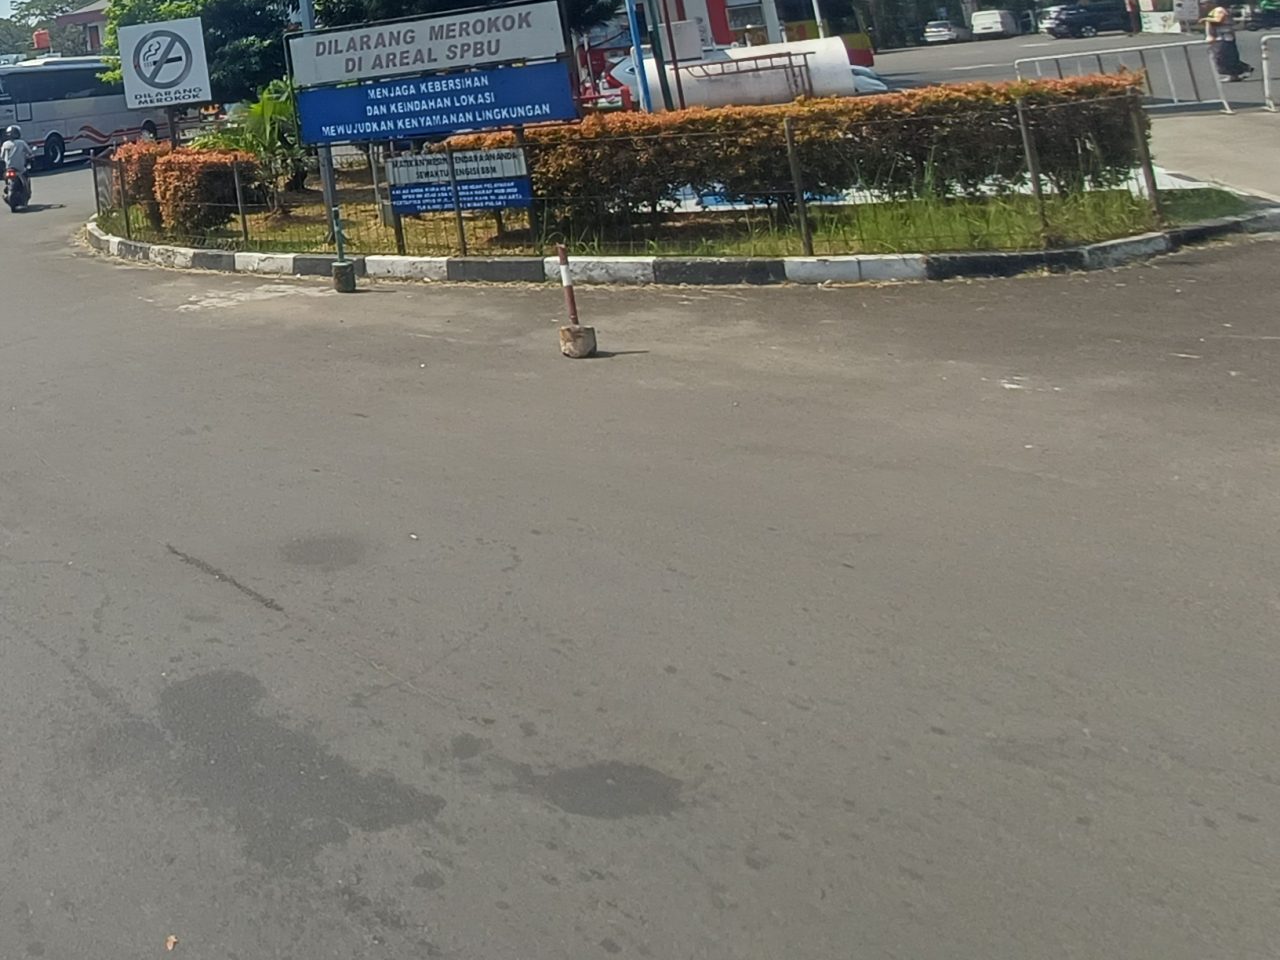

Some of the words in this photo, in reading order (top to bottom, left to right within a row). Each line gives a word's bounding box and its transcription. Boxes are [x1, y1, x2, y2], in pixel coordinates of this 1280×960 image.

[315, 28, 416, 57] DILARANG
[428, 11, 533, 41] MEROKOK
[344, 57, 363, 74] DI
[371, 46, 439, 71] AREAL
[445, 38, 502, 61] SPBU
[134, 86, 203, 101] DILARANG
[137, 93, 201, 106] MEROKOK
[367, 84, 416, 100] MENJAGA
[419, 75, 489, 94] KEBERSIHAN
[366, 103, 387, 117] DAN
[389, 96, 452, 114] KEINDAHAN
[453, 91, 496, 107] LOKASI
[321, 119, 395, 137] MEWUJUDKAN
[396, 111, 473, 130] KENYAMANAN
[474, 103, 551, 122] LINGKUNGAN
